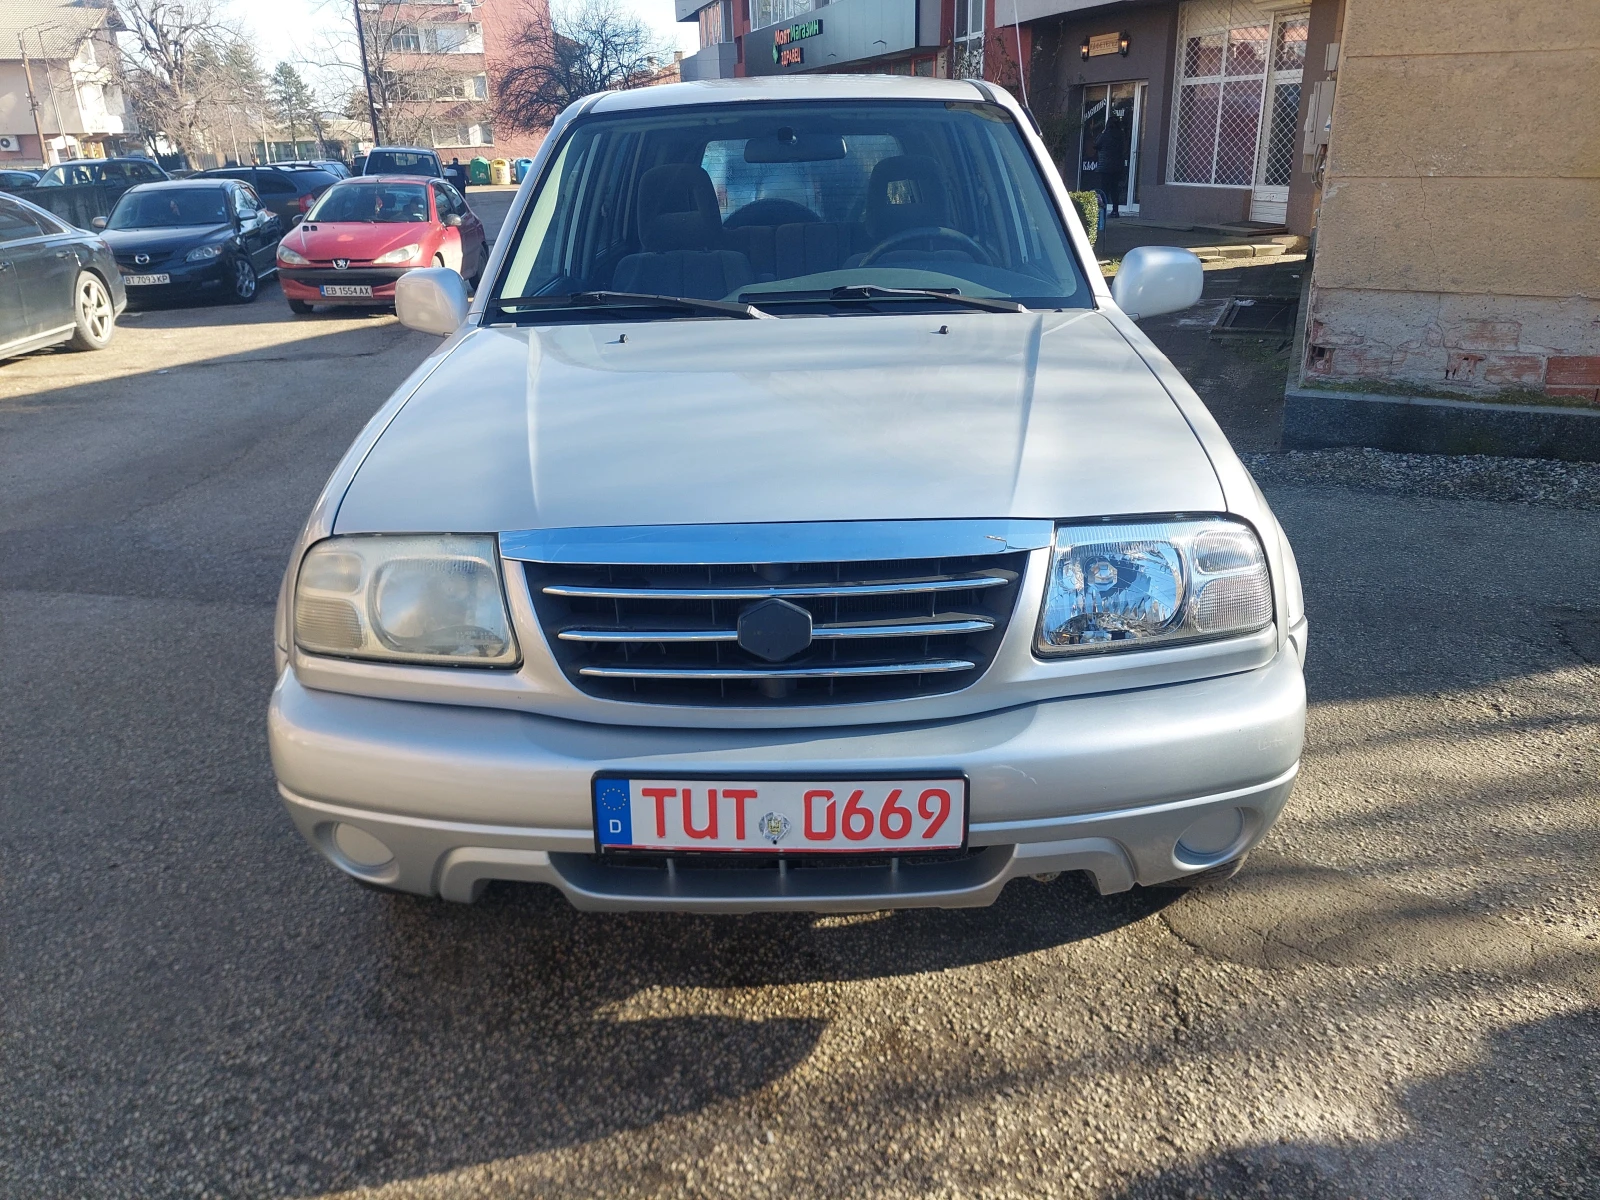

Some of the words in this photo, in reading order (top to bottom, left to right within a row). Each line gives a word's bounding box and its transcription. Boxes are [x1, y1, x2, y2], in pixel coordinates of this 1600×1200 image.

[126, 276, 136, 285] BT
[137, 276, 156, 284] 7093
[157, 275, 168, 283] KP
[326, 287, 337, 295] EB
[339, 287, 357, 295] 1554
[359, 287, 370, 295] AX
[641, 788, 758, 840] TUT
[803, 788, 951, 841] 0669
[609, 819, 622, 834] D
